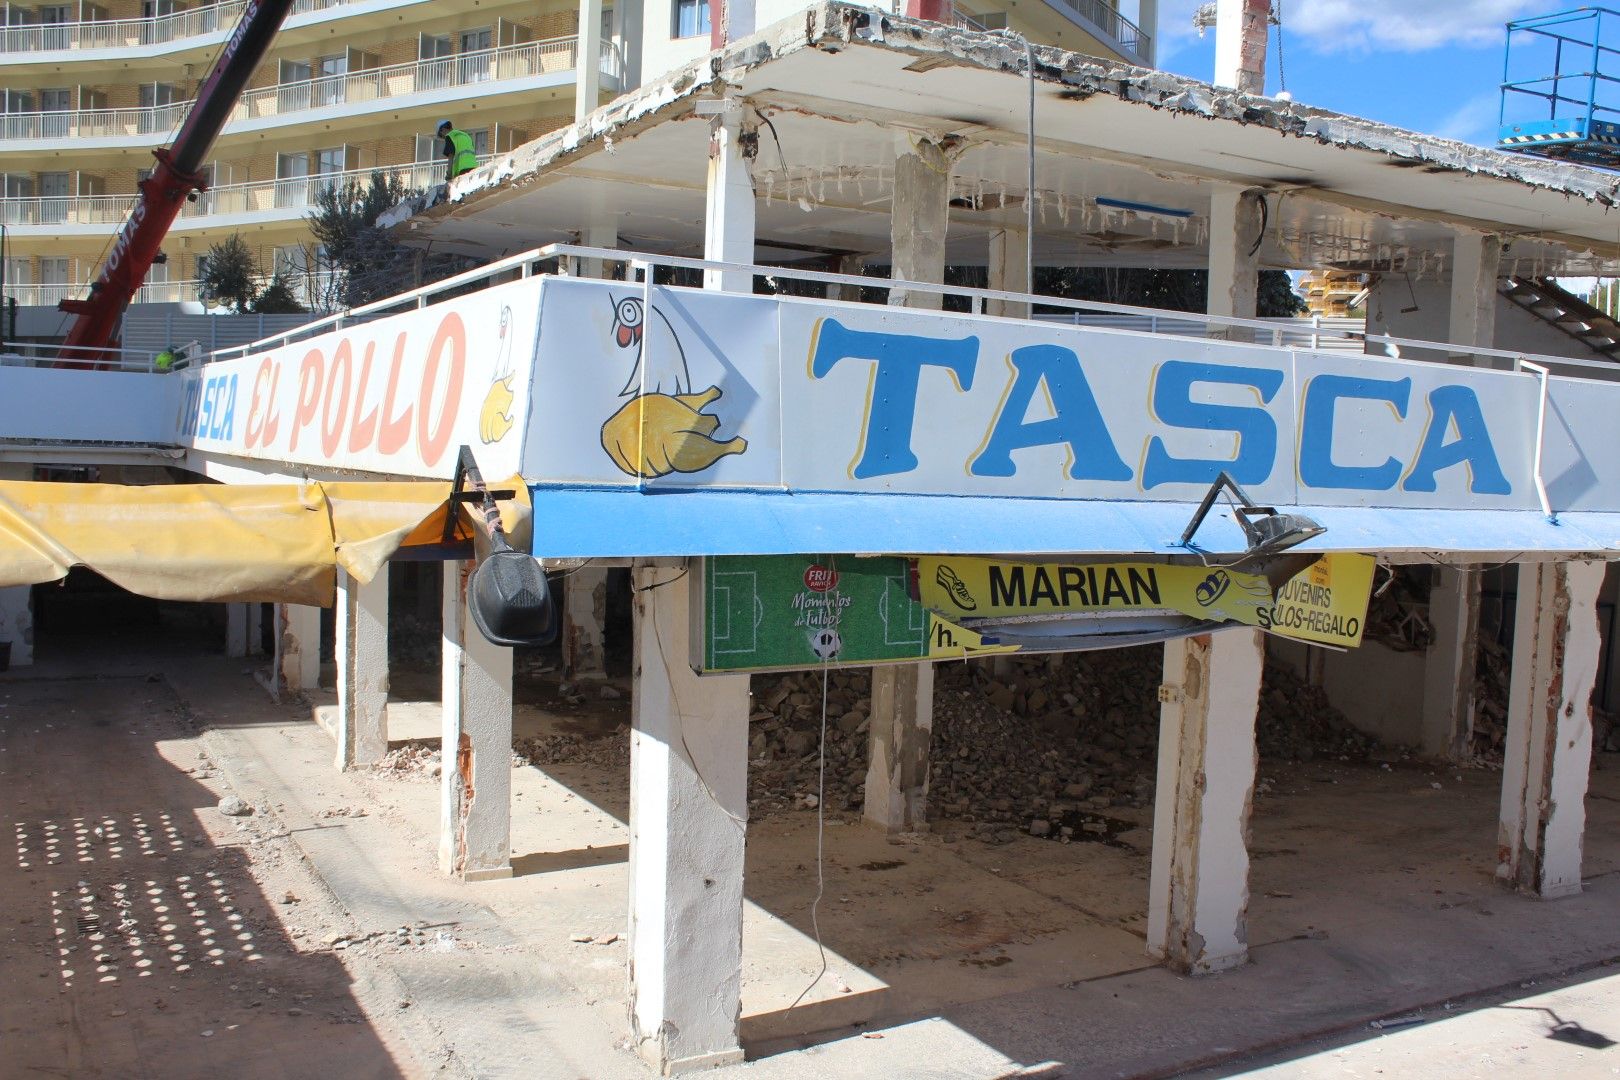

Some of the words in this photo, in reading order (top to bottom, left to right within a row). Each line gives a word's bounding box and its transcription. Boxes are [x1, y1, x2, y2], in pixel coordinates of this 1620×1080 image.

[224, 2, 258, 59] TOMAS
[101, 205, 146, 283] TOMAS
[177, 373, 239, 440] TASCA
[245, 356, 281, 450] EL
[289, 311, 467, 467] POLLO
[806, 316, 1512, 496] TASCA
[988, 565, 1162, 607] MARIAN
